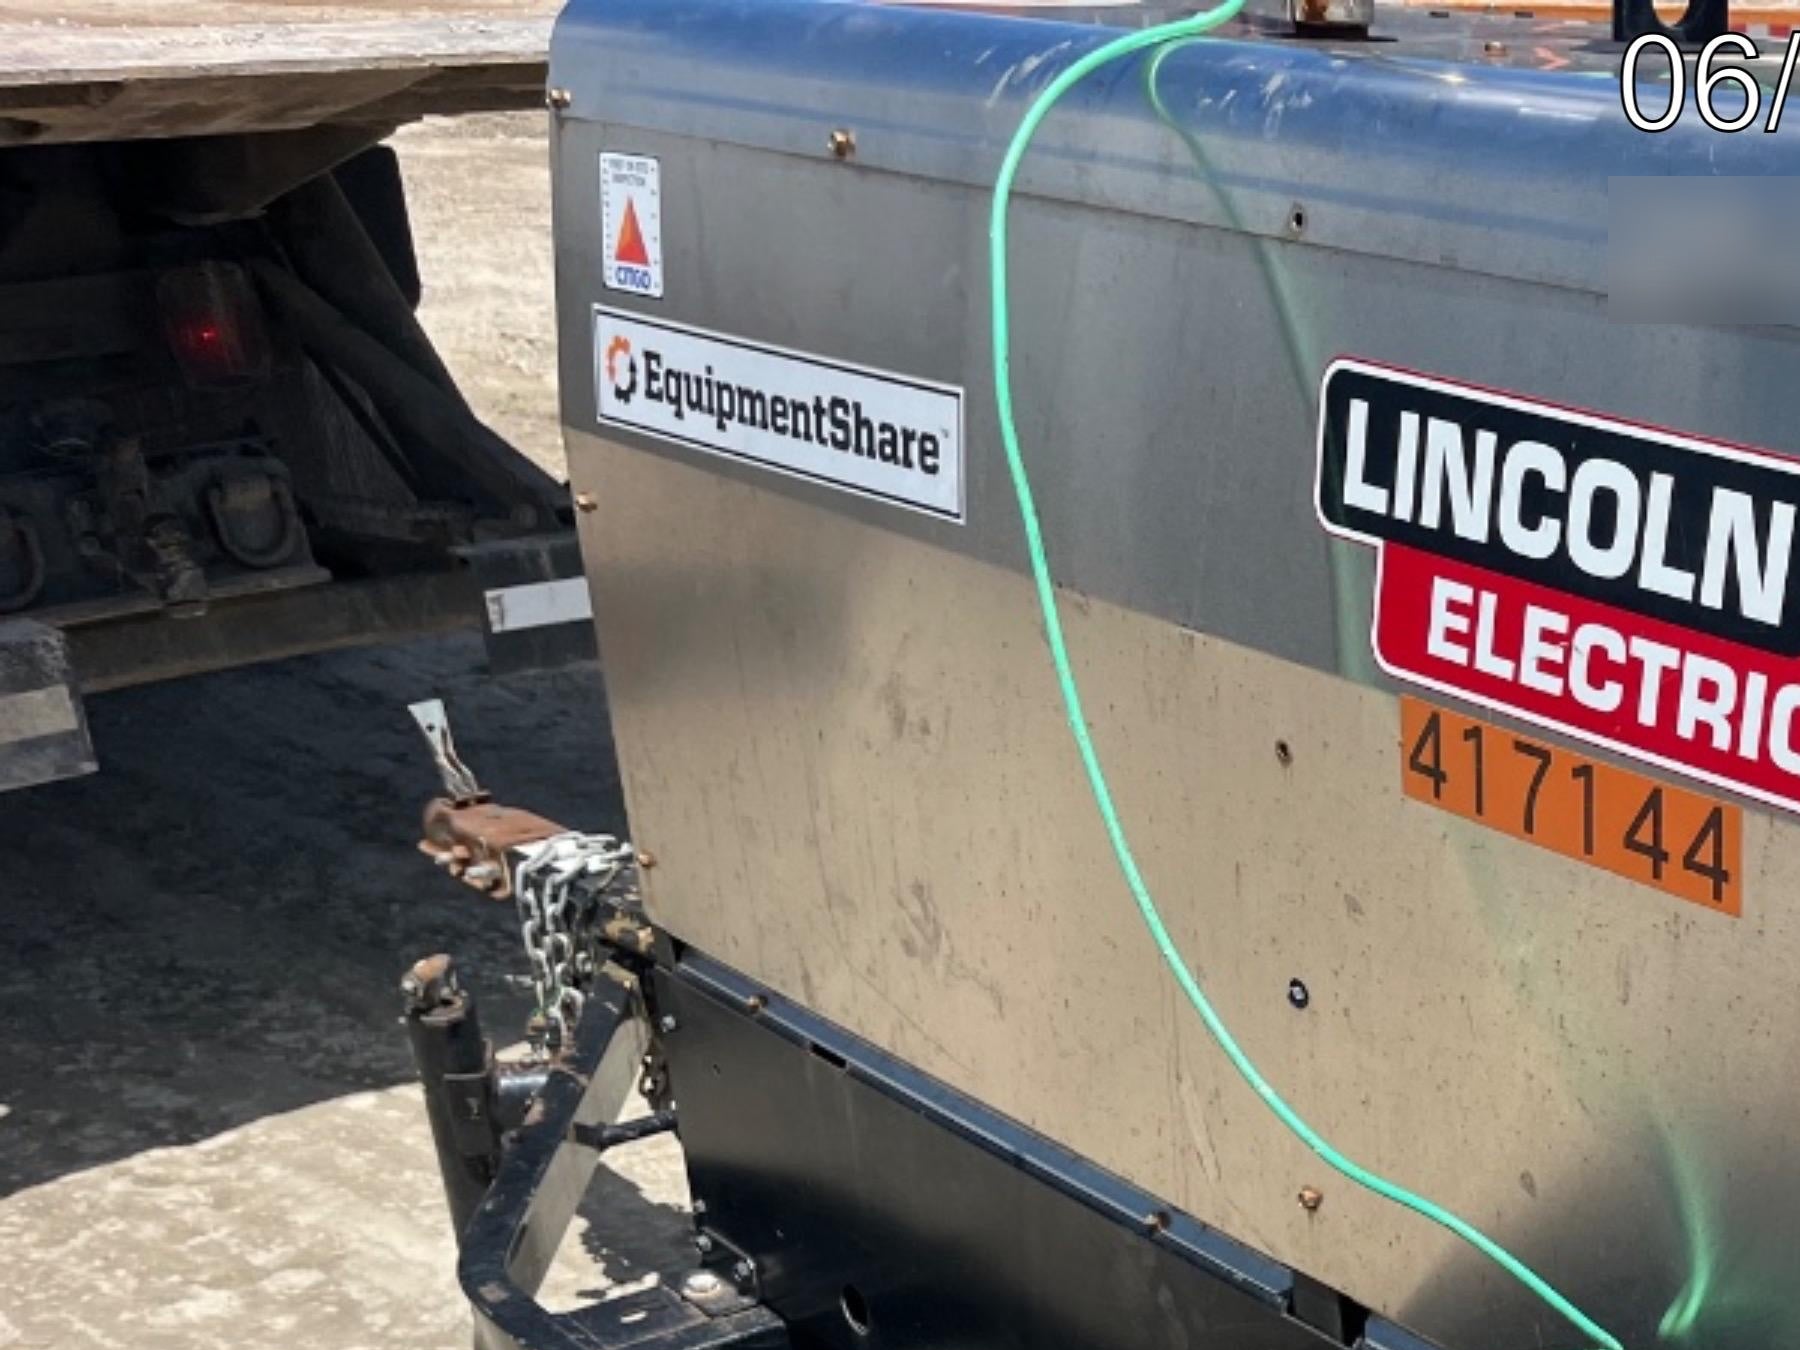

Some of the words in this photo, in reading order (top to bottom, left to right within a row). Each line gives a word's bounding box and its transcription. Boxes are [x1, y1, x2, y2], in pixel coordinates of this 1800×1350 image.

[642, 350, 940, 476] EquipmentShare
[1342, 398, 1797, 627] LINCOLN
[1408, 710, 1730, 903] 417144
